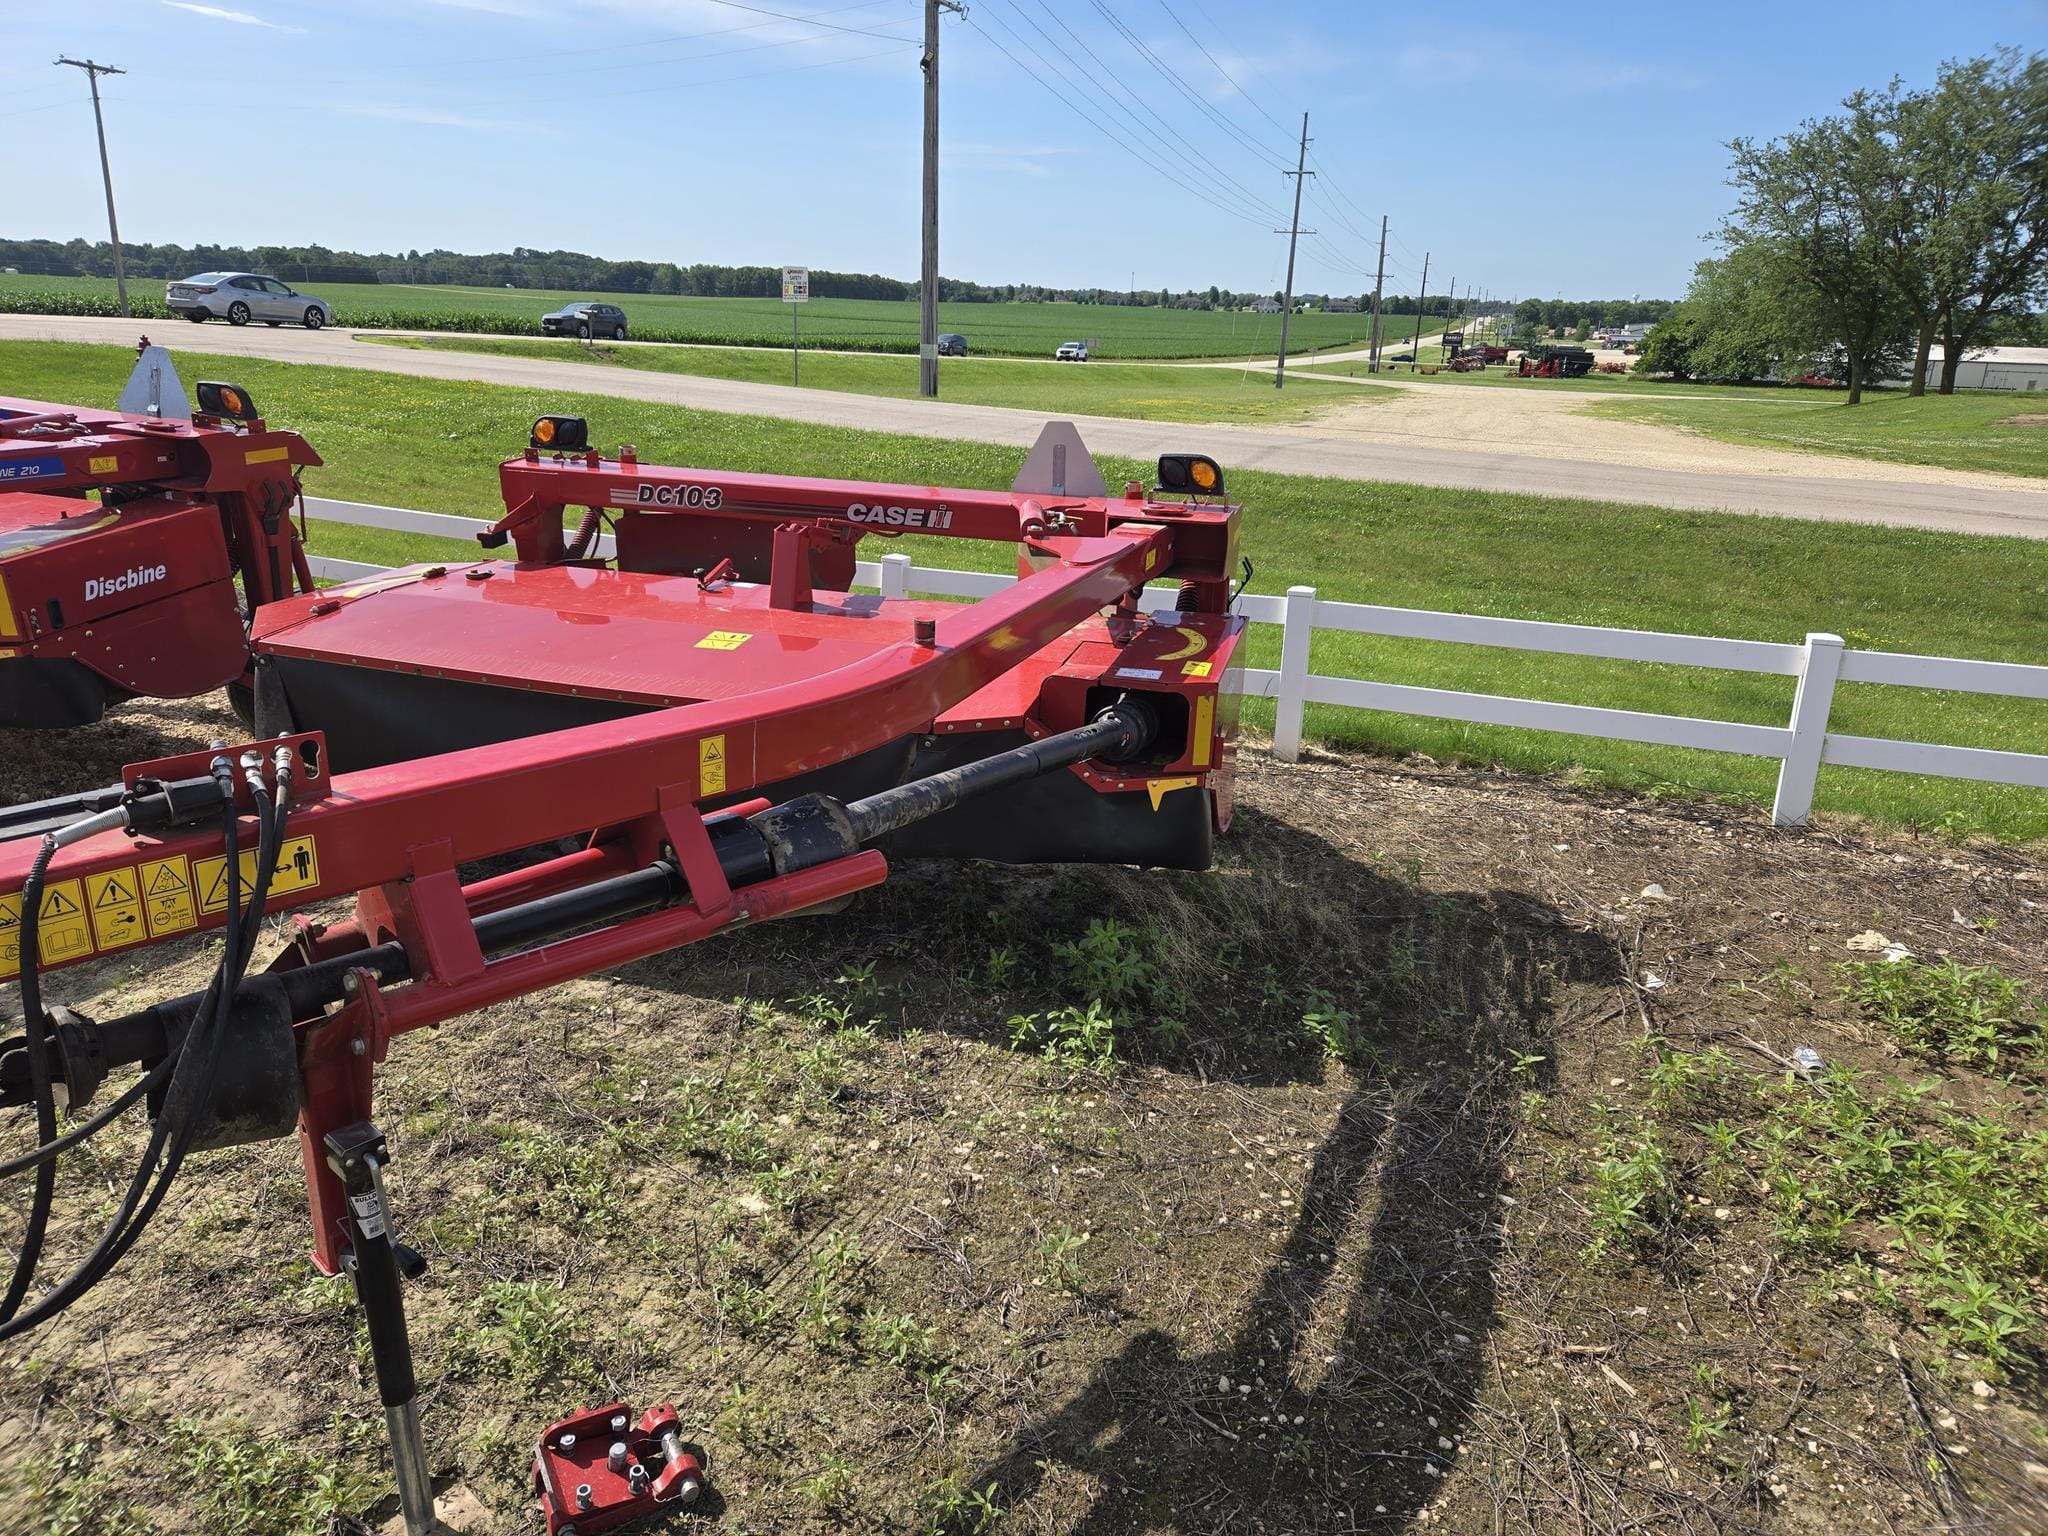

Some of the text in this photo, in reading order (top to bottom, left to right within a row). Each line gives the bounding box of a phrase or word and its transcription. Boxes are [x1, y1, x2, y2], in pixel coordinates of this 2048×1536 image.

[20, 465, 40, 476] 210
[637, 484, 722, 509] DC103
[847, 503, 925, 527] CASE
[85, 564, 166, 602] Discbine
